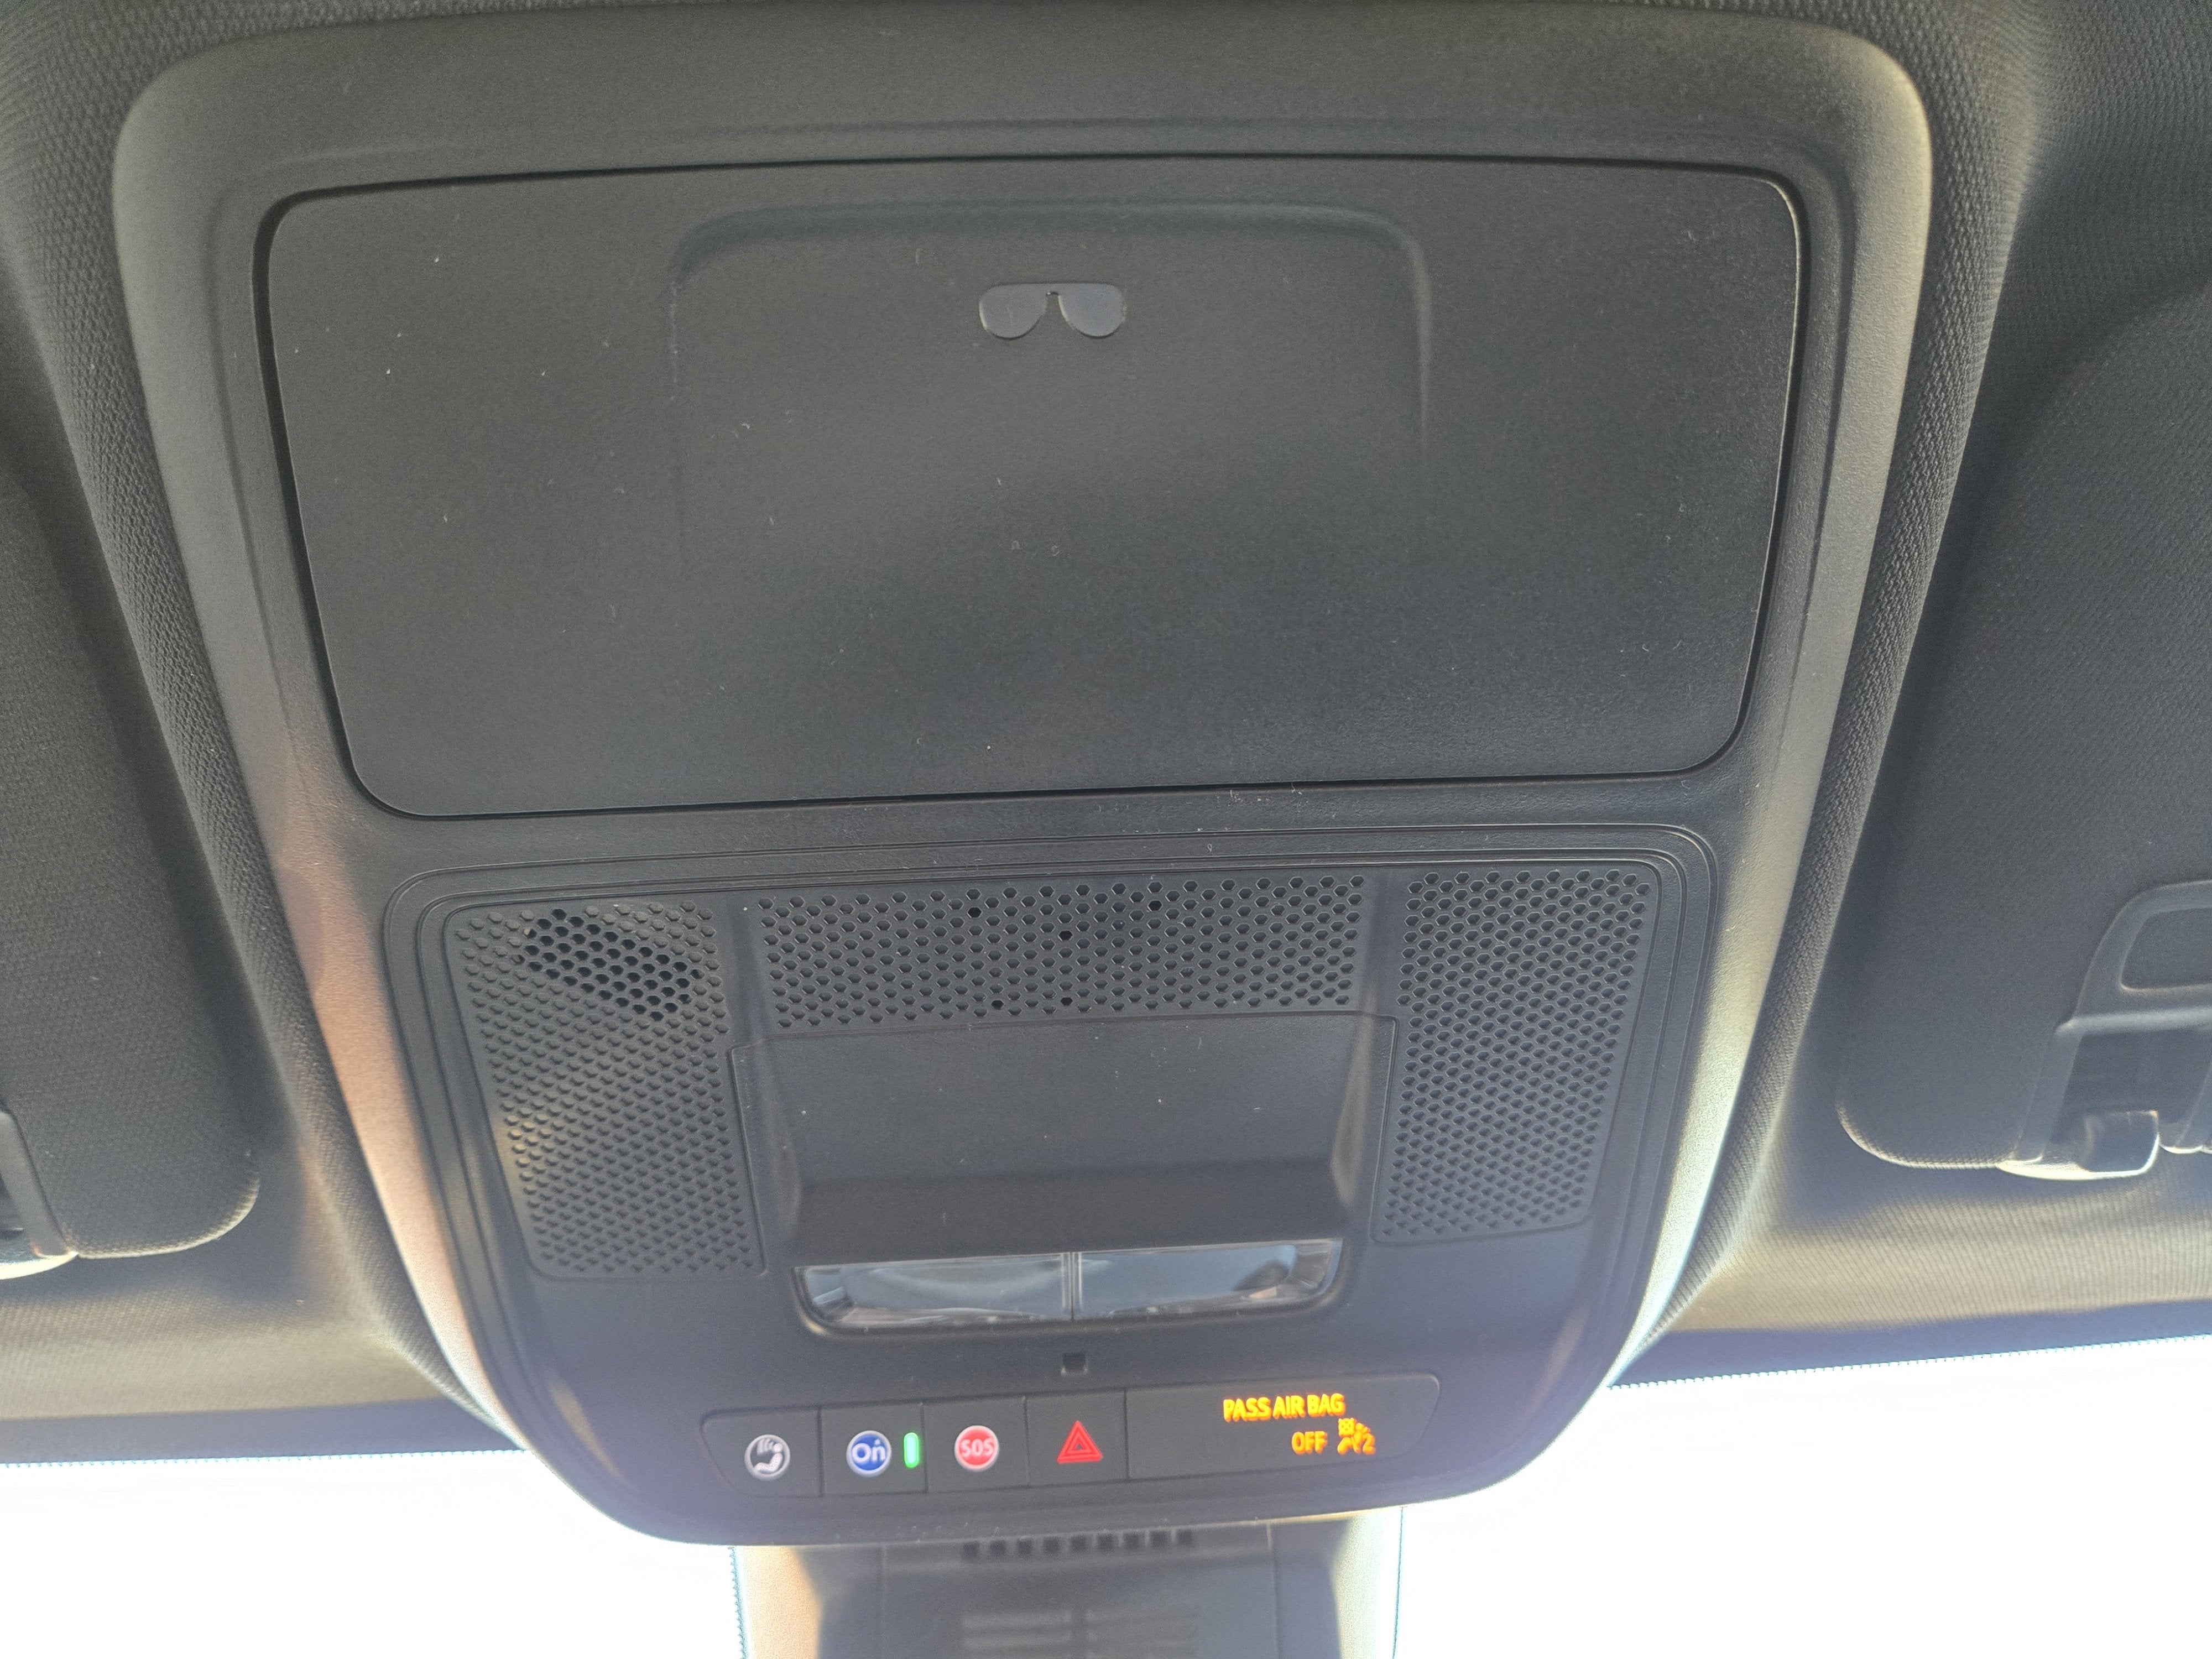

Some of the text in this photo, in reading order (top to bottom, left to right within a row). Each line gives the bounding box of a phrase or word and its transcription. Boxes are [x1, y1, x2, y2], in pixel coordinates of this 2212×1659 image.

[1223, 1392, 1345, 1421] PASS AIR BAG
[852, 1441, 885, 1462] On
[961, 1438, 994, 1457] SOS
[1292, 1431, 1328, 1454] OFF
